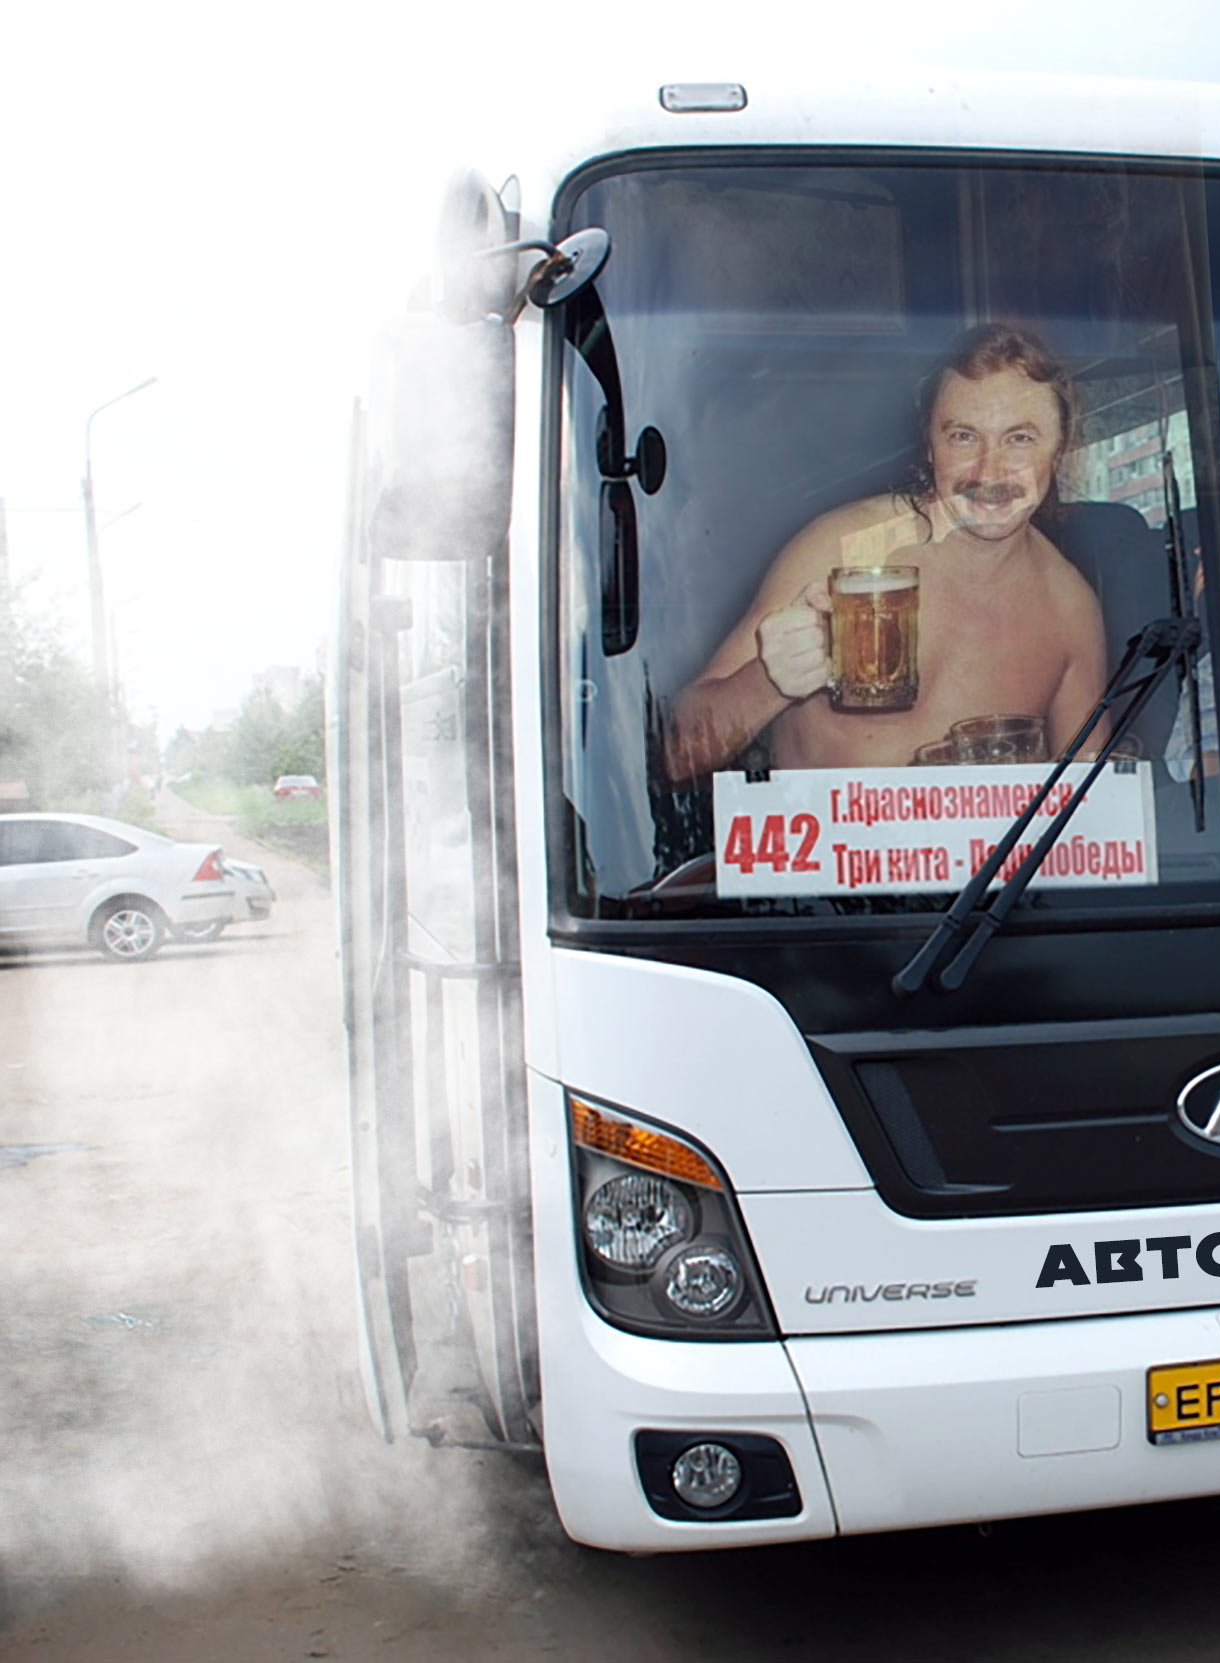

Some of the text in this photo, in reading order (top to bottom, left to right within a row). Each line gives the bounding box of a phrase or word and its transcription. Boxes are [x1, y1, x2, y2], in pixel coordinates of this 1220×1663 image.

[723, 812, 821, 874] 442
[832, 844, 882, 888] Три
[887, 847, 950, 882] кита
[970, 839, 1035, 884] Пр
[1039, 835, 1144, 880] победы
[804, 1279, 978, 1305] UNIVERSE
